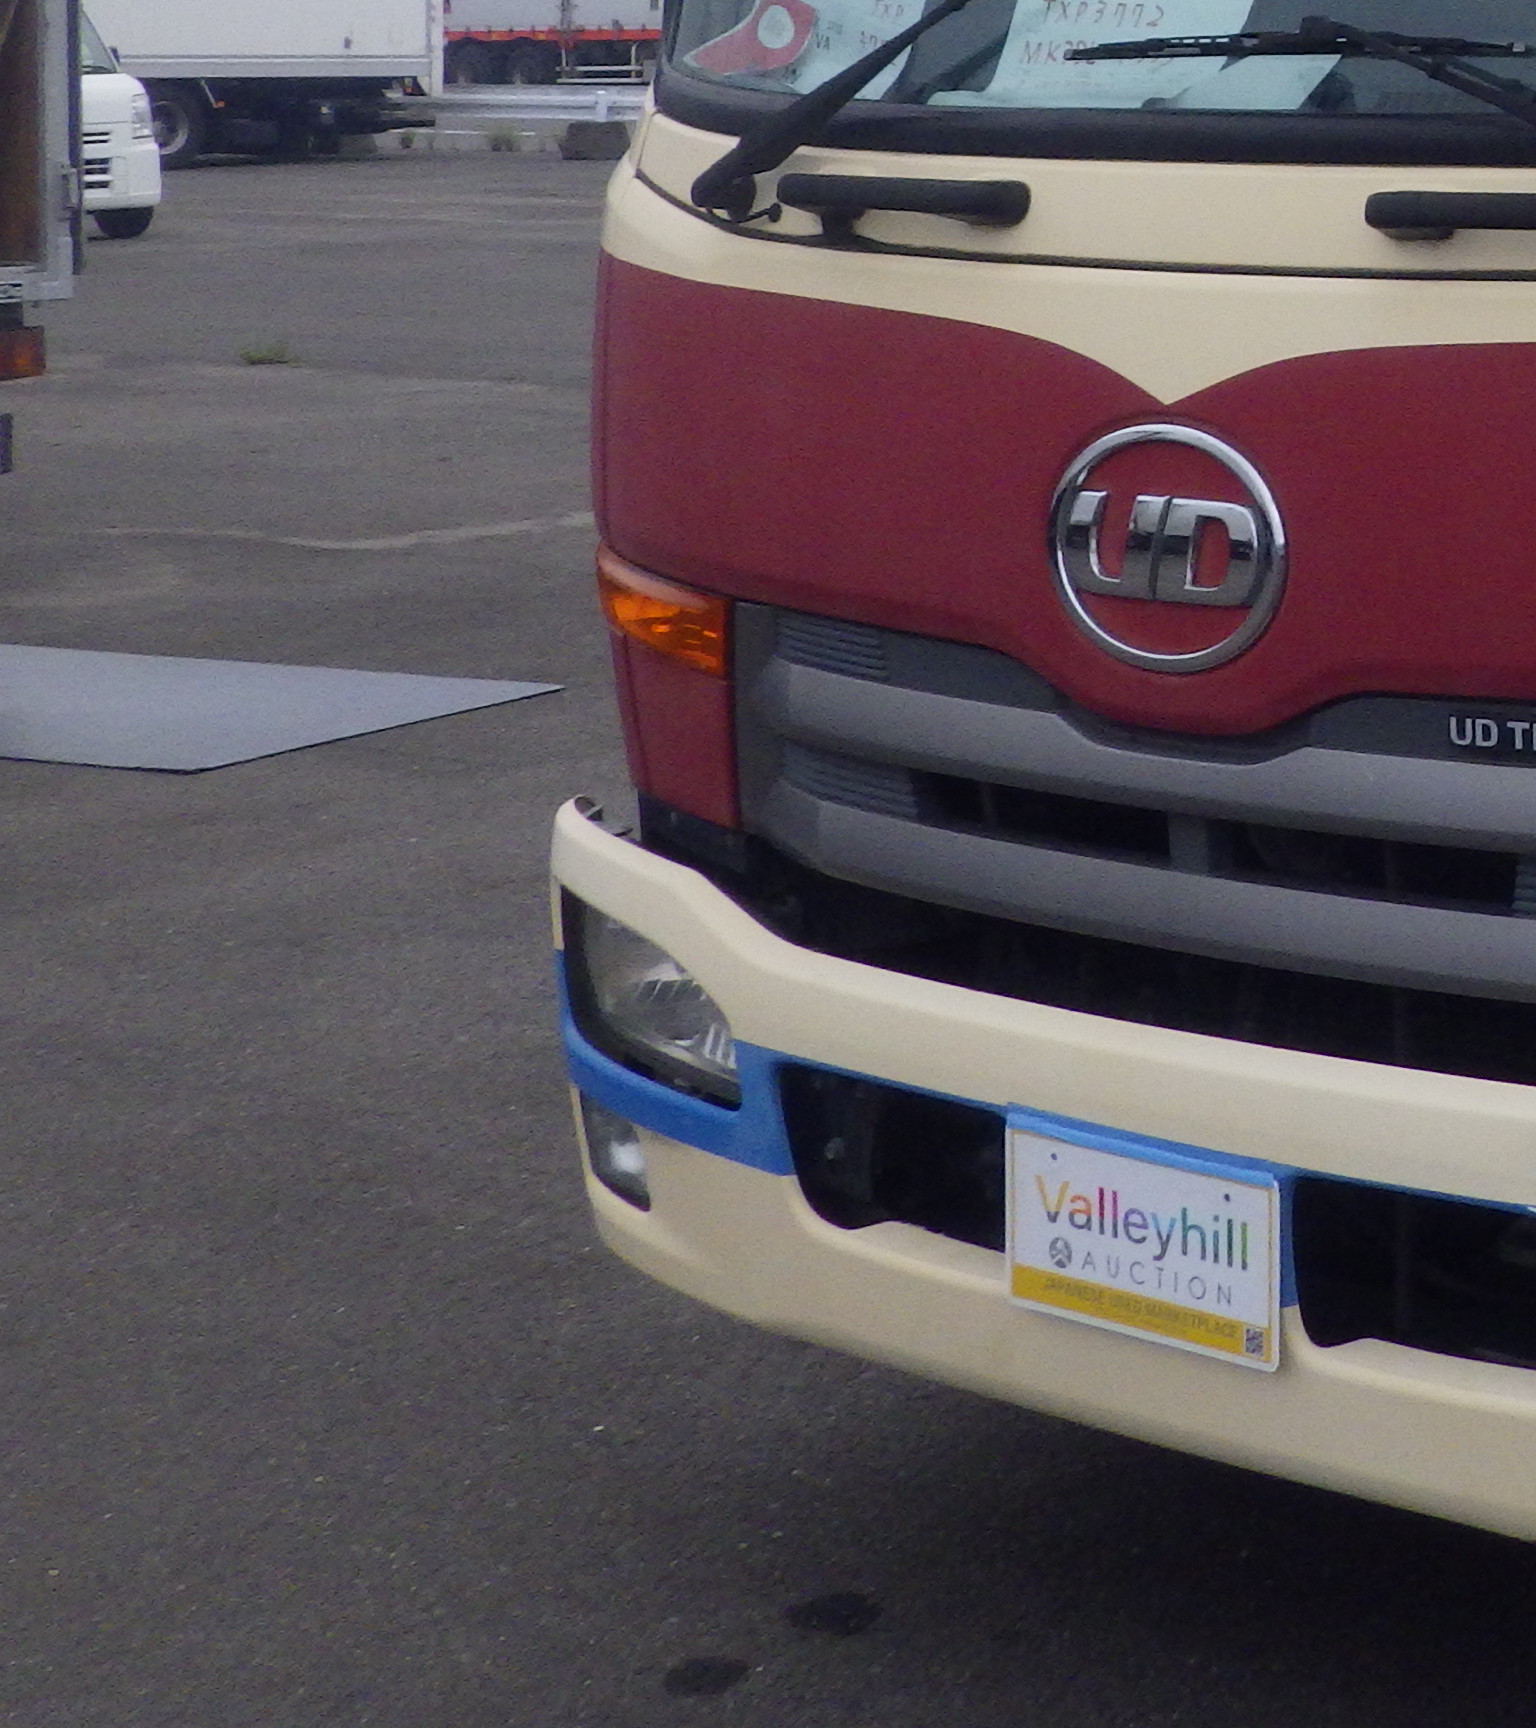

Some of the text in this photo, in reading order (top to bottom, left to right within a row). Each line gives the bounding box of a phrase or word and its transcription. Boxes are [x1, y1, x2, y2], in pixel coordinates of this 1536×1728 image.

[1064, 489, 1258, 608] UD
[1449, 716, 1499, 747] UD
[1035, 1174, 1248, 1271] Valleyhill
[1081, 1251, 1232, 1306] AUCTION
